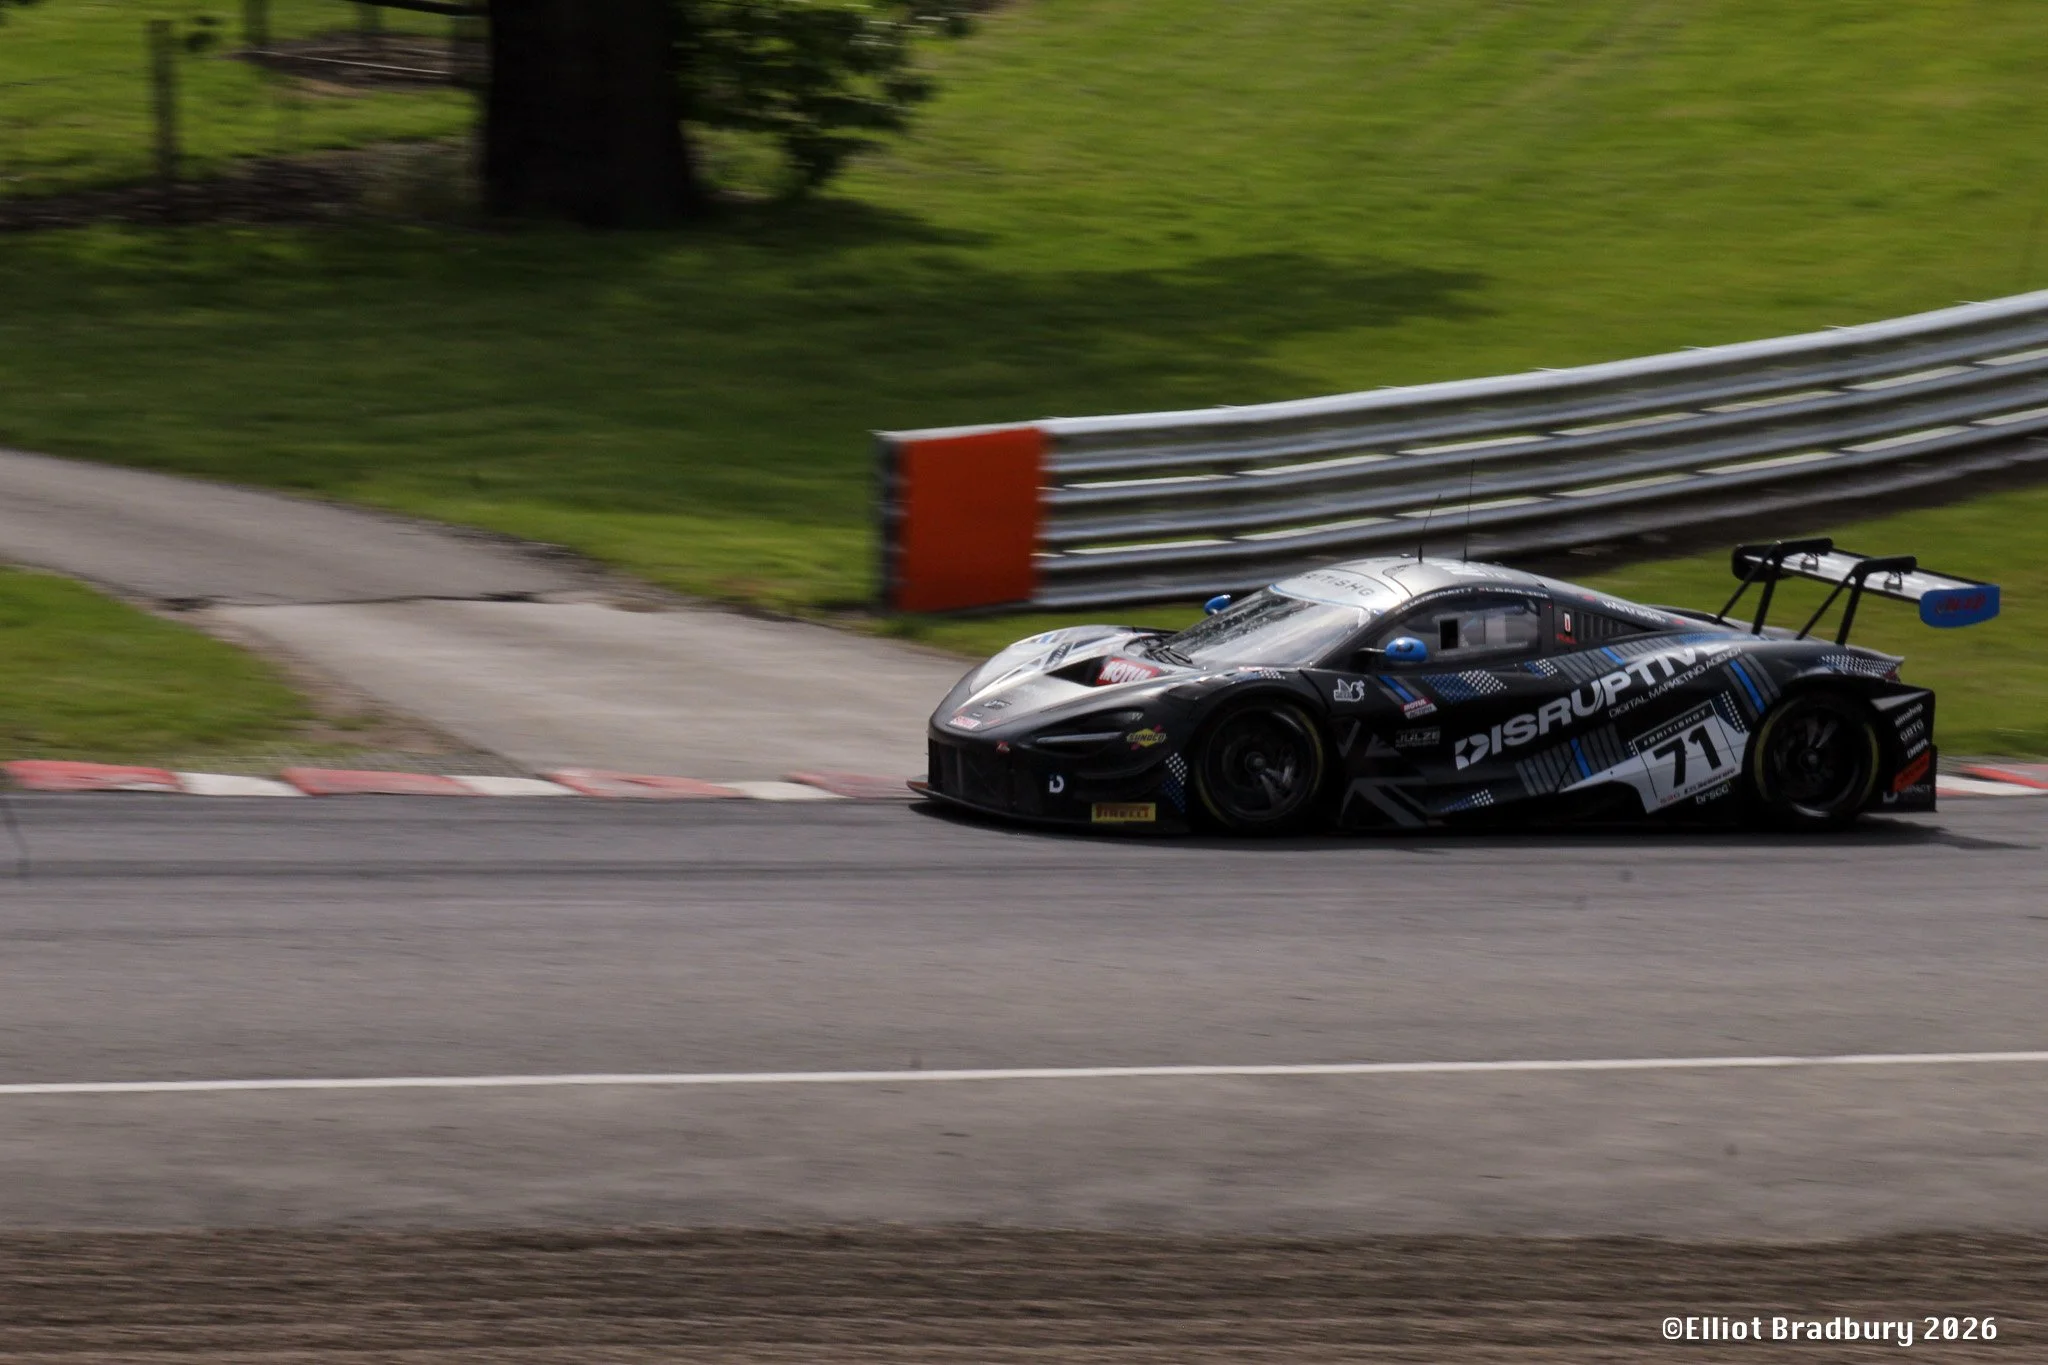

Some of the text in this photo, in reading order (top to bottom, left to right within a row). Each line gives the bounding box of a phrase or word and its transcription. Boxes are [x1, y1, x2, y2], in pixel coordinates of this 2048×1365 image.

[1608, 694, 1649, 719] DIGITAL
[1648, 662, 1706, 700] MARKETING
[1126, 732, 1167, 745] SUNOCO
[1652, 724, 1722, 789] 71
